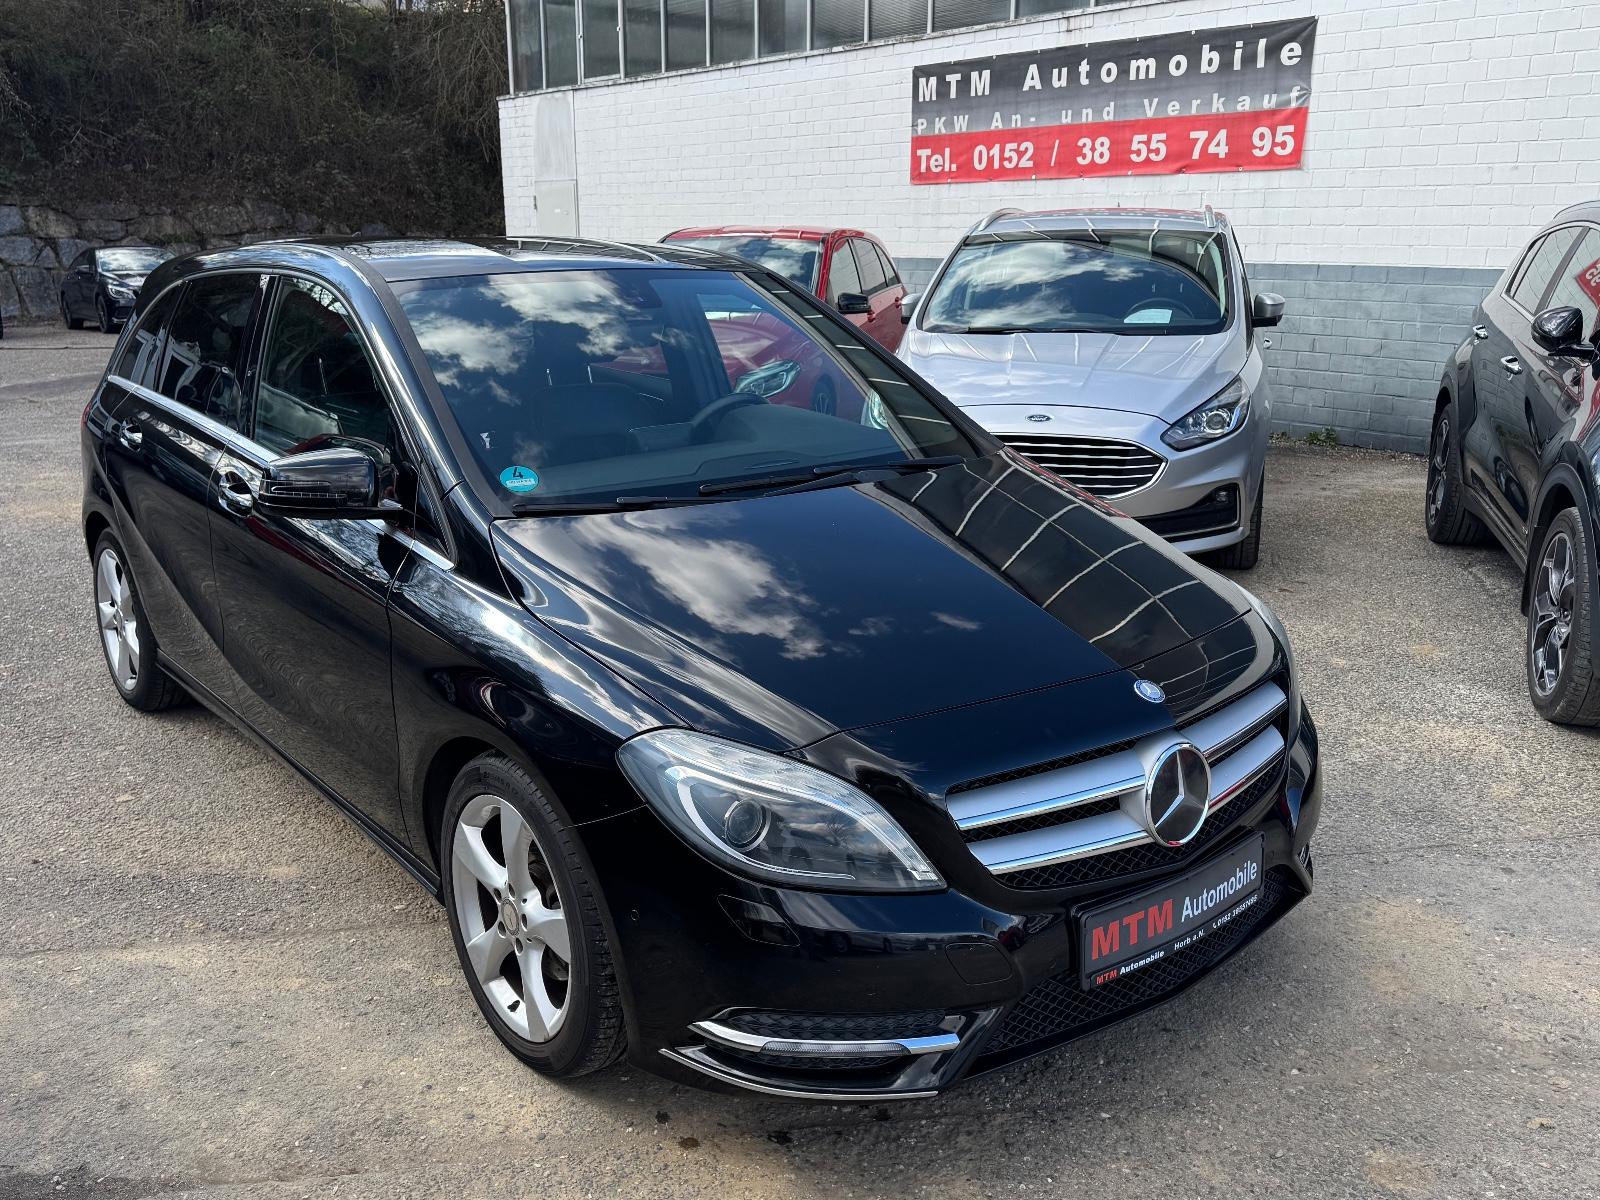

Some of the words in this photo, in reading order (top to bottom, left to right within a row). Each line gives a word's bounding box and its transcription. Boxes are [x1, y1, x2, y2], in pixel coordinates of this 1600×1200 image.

[918, 70, 991, 102] MTM
[1023, 38, 1302, 91] Automobile
[917, 114, 970, 135] PKW
[990, 112, 1037, 130] An-
[1061, 101, 1115, 125] und
[1143, 86, 1302, 118] Verkauf
[916, 148, 957, 173] Tel.
[973, 141, 1034, 171] 0152
[1050, 139, 1060, 167] /
[1076, 136, 1110, 165] 38
[1130, 133, 1167, 163] 55
[1190, 129, 1229, 160] 74
[1251, 125, 1295, 158] 95
[512, 467, 524, 479] 4
[1091, 899, 1173, 960] MTM
[1181, 860, 1257, 923] Automobile
[1096, 970, 1118, 985] MTM
[1120, 950, 1165, 975] Automobile
[1174, 936, 1191, 951] Horb
